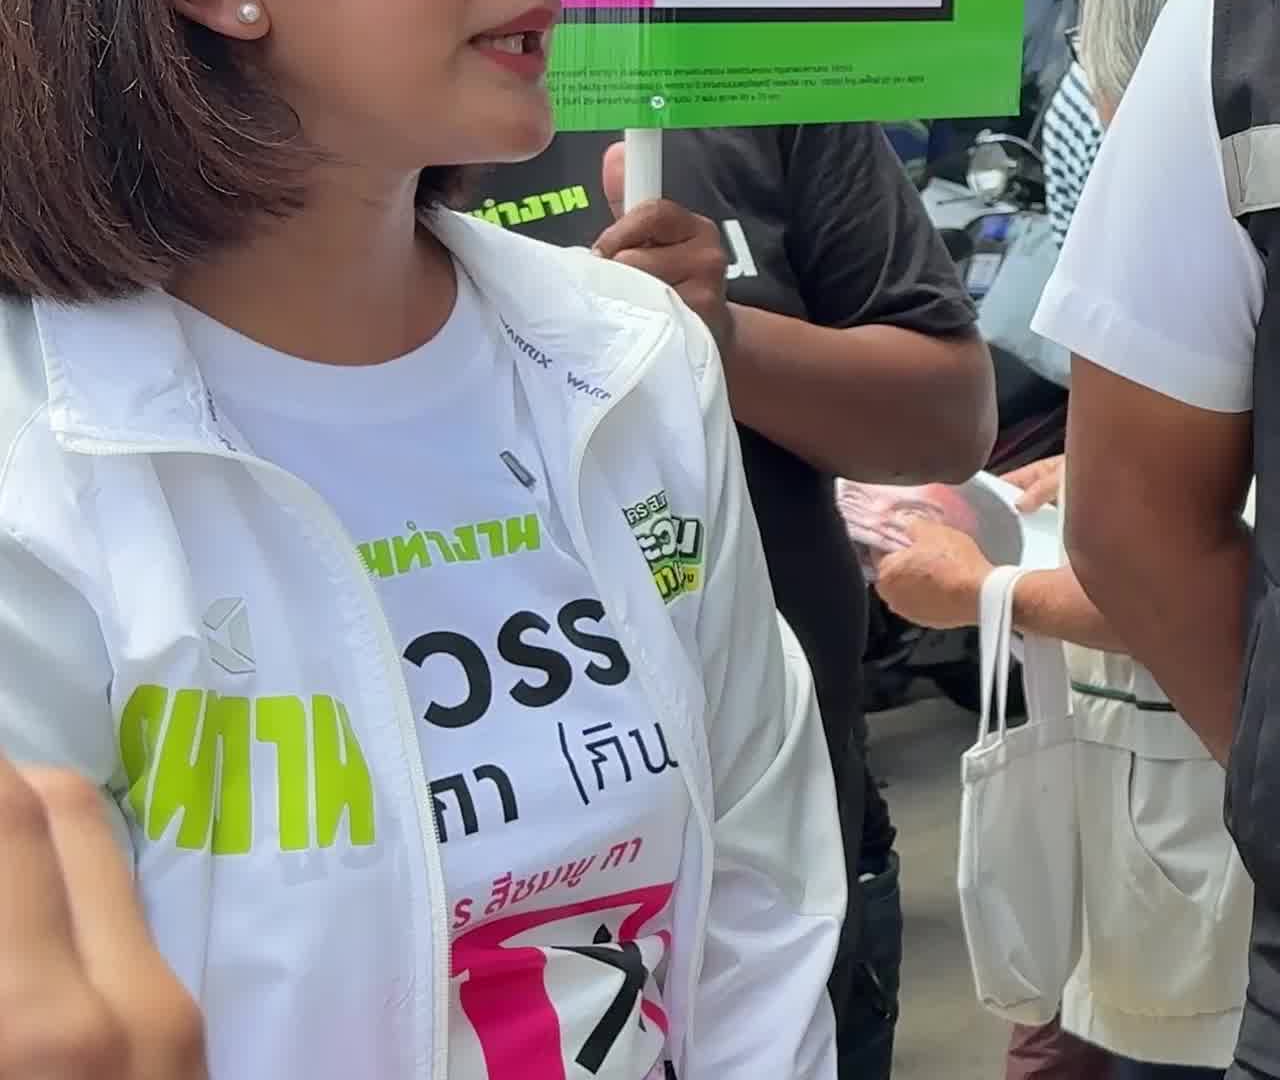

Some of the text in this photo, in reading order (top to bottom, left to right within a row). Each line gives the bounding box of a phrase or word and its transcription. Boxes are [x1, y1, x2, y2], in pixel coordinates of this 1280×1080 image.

[356, 513, 541, 579] นทำงาน
[600, 836, 643, 871] กา
